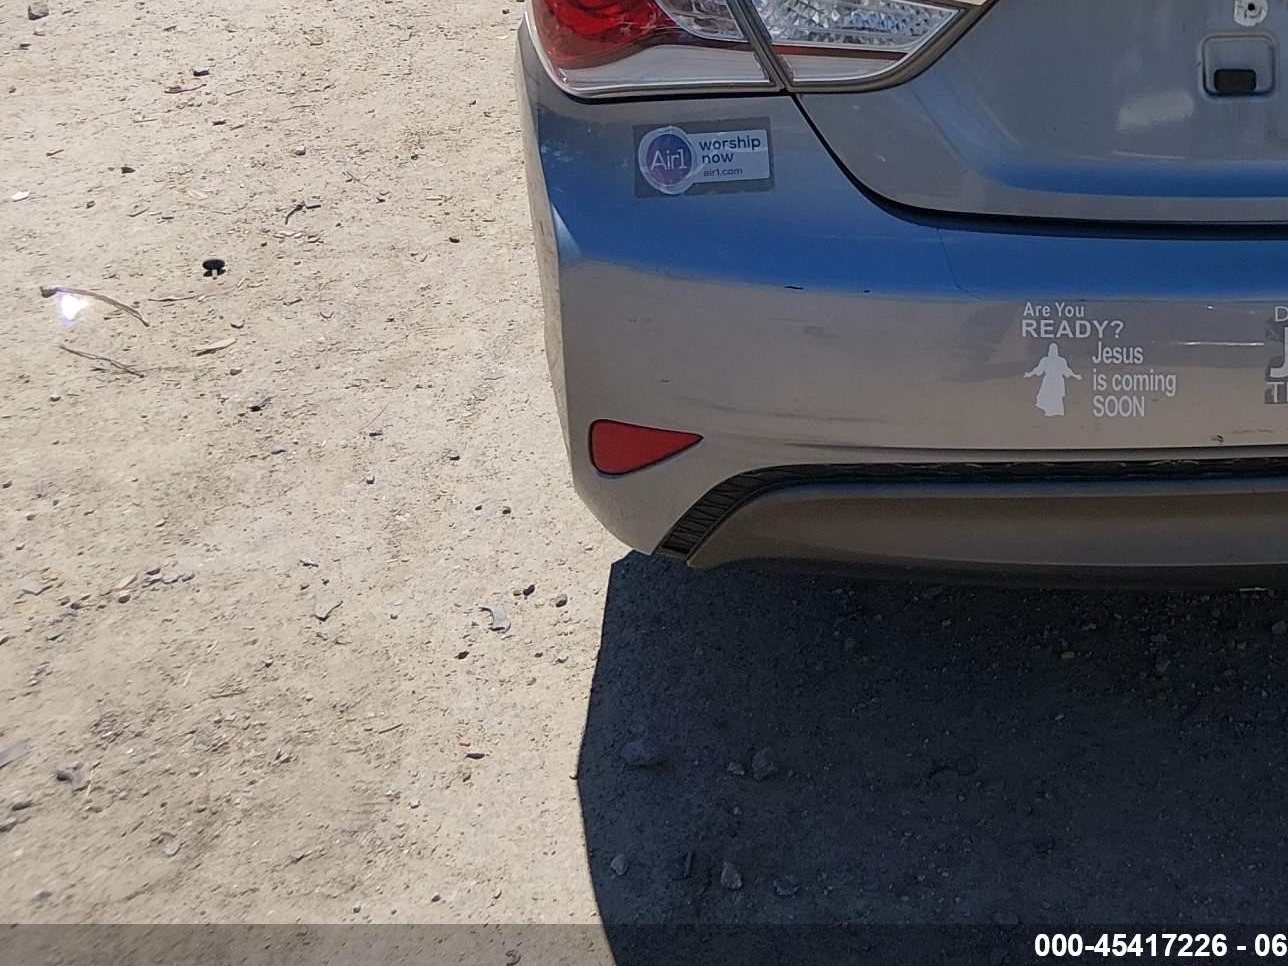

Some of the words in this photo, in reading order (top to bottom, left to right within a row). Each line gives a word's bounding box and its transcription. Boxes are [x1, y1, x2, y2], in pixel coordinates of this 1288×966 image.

[699, 135, 761, 151] worship
[650, 148, 688, 171] Air1
[702, 152, 734, 164] now
[703, 167, 743, 177] air1.com
[1023, 301, 1051, 317] Are
[1055, 301, 1085, 317] You
[1021, 319, 1125, 339] READY?
[1092, 341, 1144, 364] Jesus
[1093, 369, 1108, 391] is
[1112, 369, 1177, 397] coming
[1092, 395, 1145, 417] SOON
